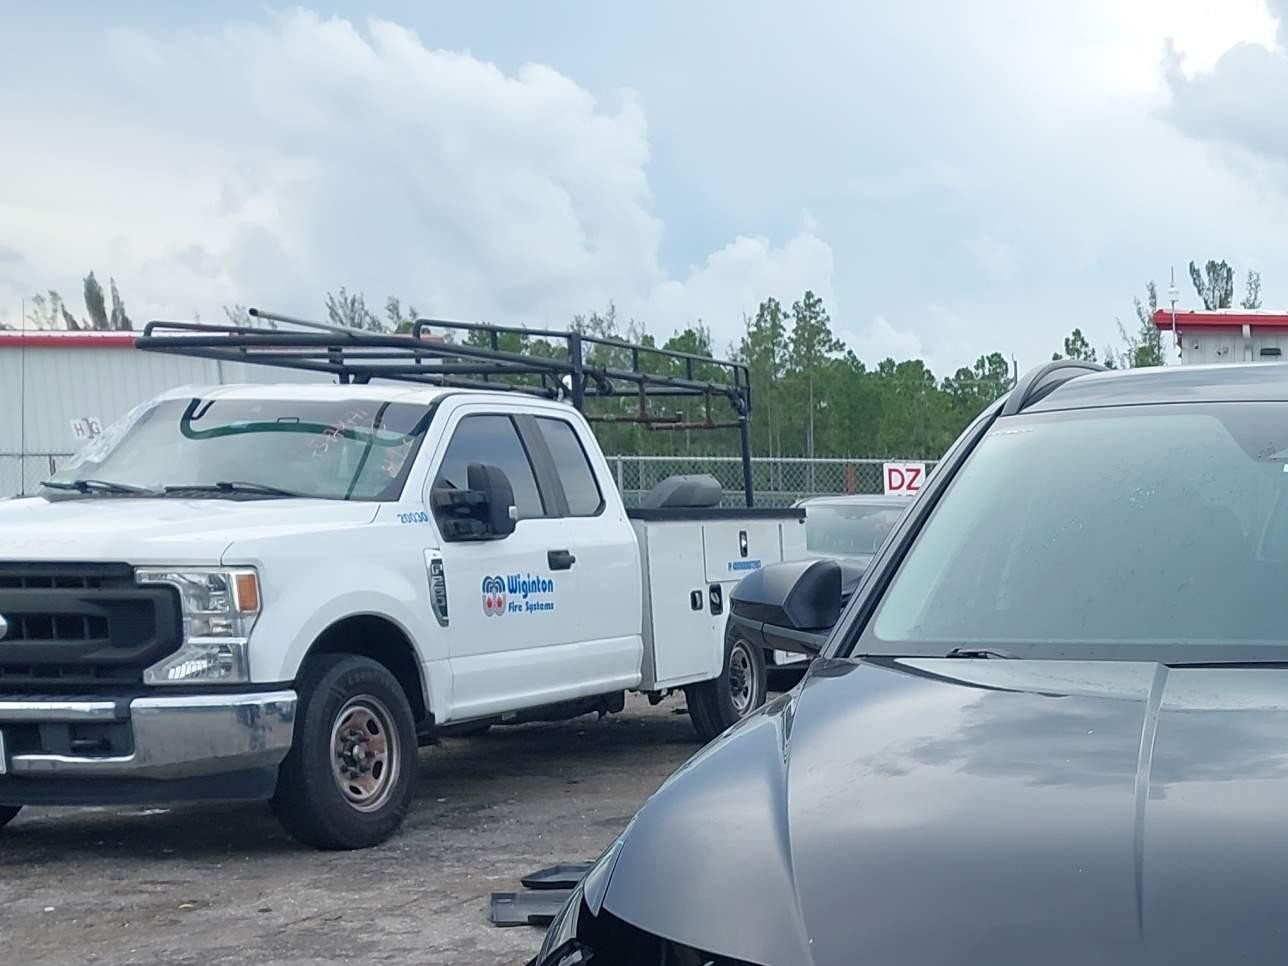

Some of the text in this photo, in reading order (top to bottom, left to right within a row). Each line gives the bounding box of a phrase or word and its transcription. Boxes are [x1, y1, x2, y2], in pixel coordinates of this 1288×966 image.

[888, 468, 921, 490] DZ
[507, 573, 554, 599] Wiginton
[508, 601, 554, 614] Fire Systems
